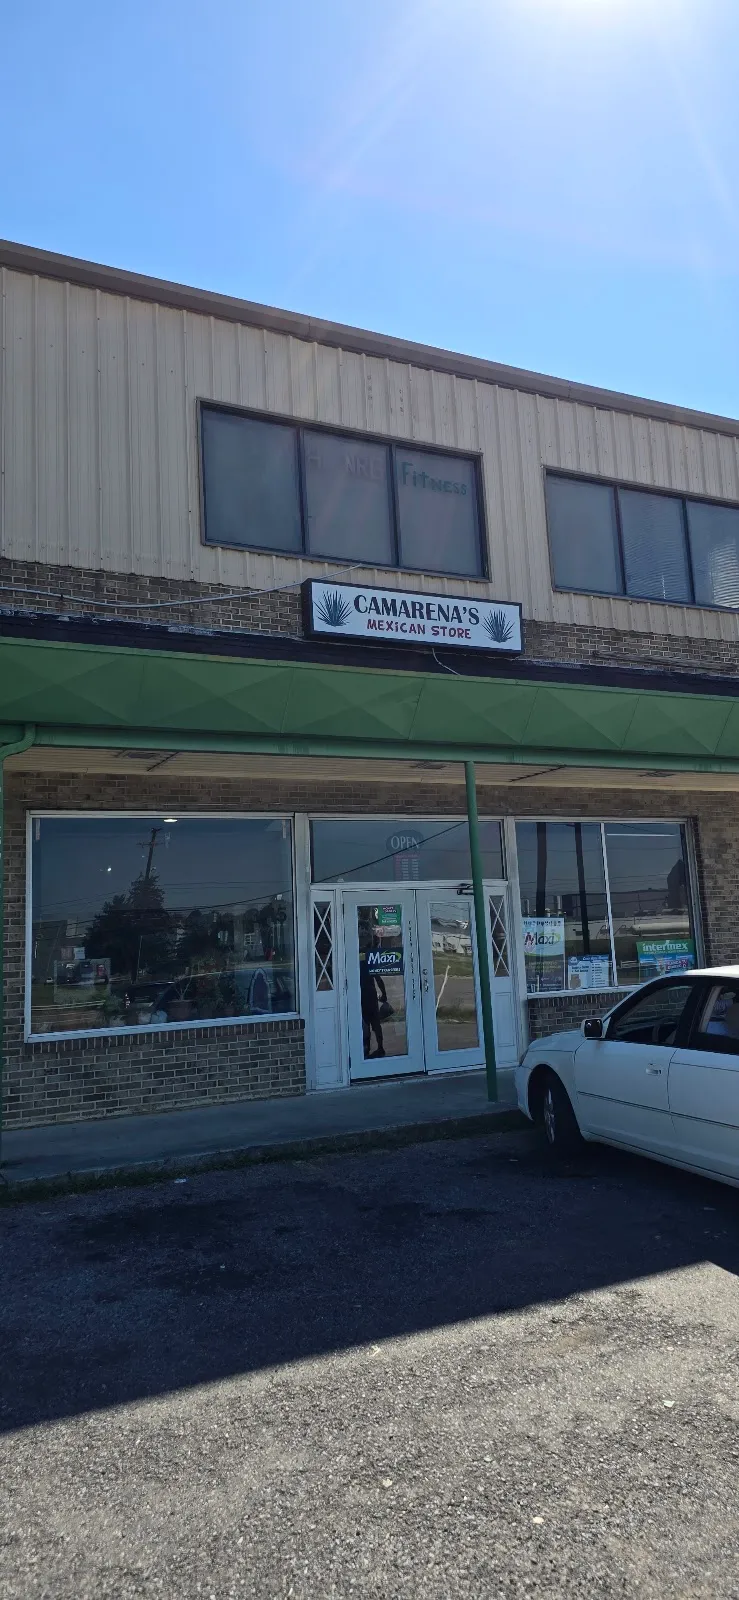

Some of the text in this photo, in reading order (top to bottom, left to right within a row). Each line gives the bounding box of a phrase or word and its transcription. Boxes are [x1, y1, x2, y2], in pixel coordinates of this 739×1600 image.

[354, 594, 480, 625] CAMARENA'S
[431, 625, 472, 640] STORE
[391, 835, 420, 850] OPEN
[642, 940, 689, 952] intermex
[367, 951, 397, 965] Maxi
